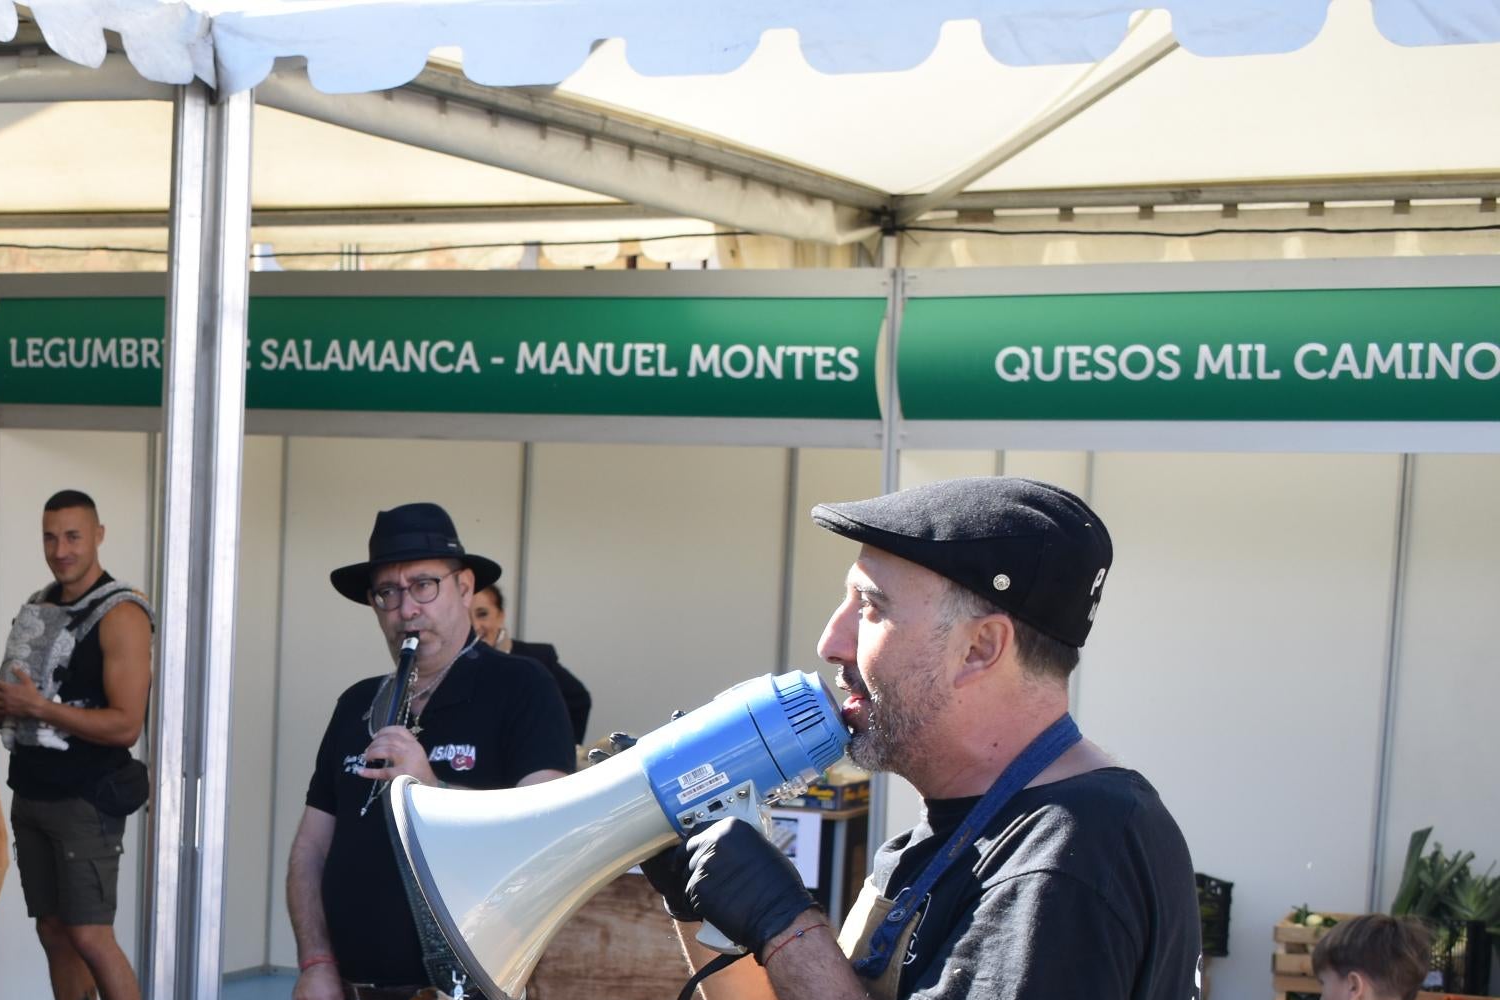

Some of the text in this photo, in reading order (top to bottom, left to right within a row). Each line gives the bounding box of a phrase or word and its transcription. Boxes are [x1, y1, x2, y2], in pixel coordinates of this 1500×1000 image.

[260, 338, 481, 374] SALAMANCA
[515, 341, 678, 378] MANUEL
[687, 343, 860, 382] MONTES
[994, 342, 1500, 382] QUESOS MIL CAMINO
